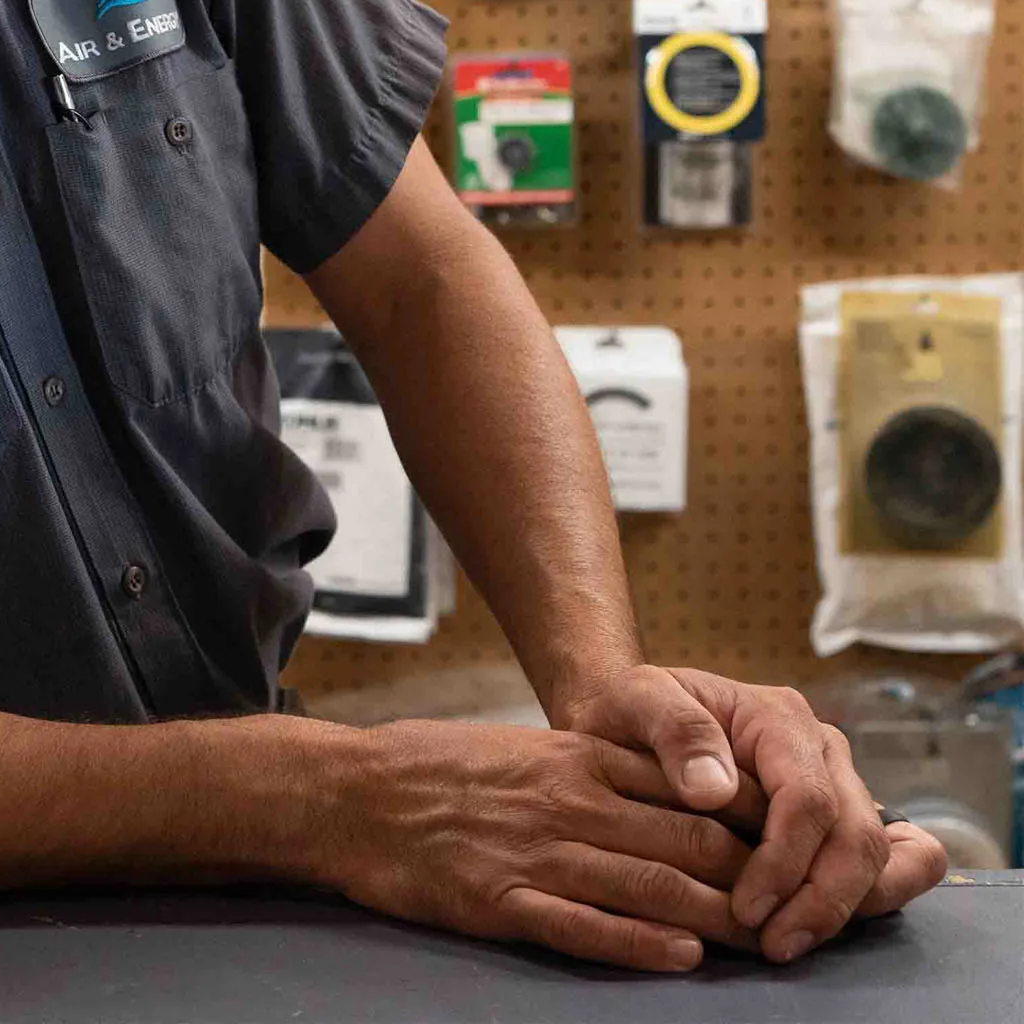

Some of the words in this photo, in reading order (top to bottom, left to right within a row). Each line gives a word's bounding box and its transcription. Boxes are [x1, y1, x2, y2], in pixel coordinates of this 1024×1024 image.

[58, 40, 101, 64] AIR
[106, 31, 125, 52] &
[127, 11, 179, 43] ENERG
